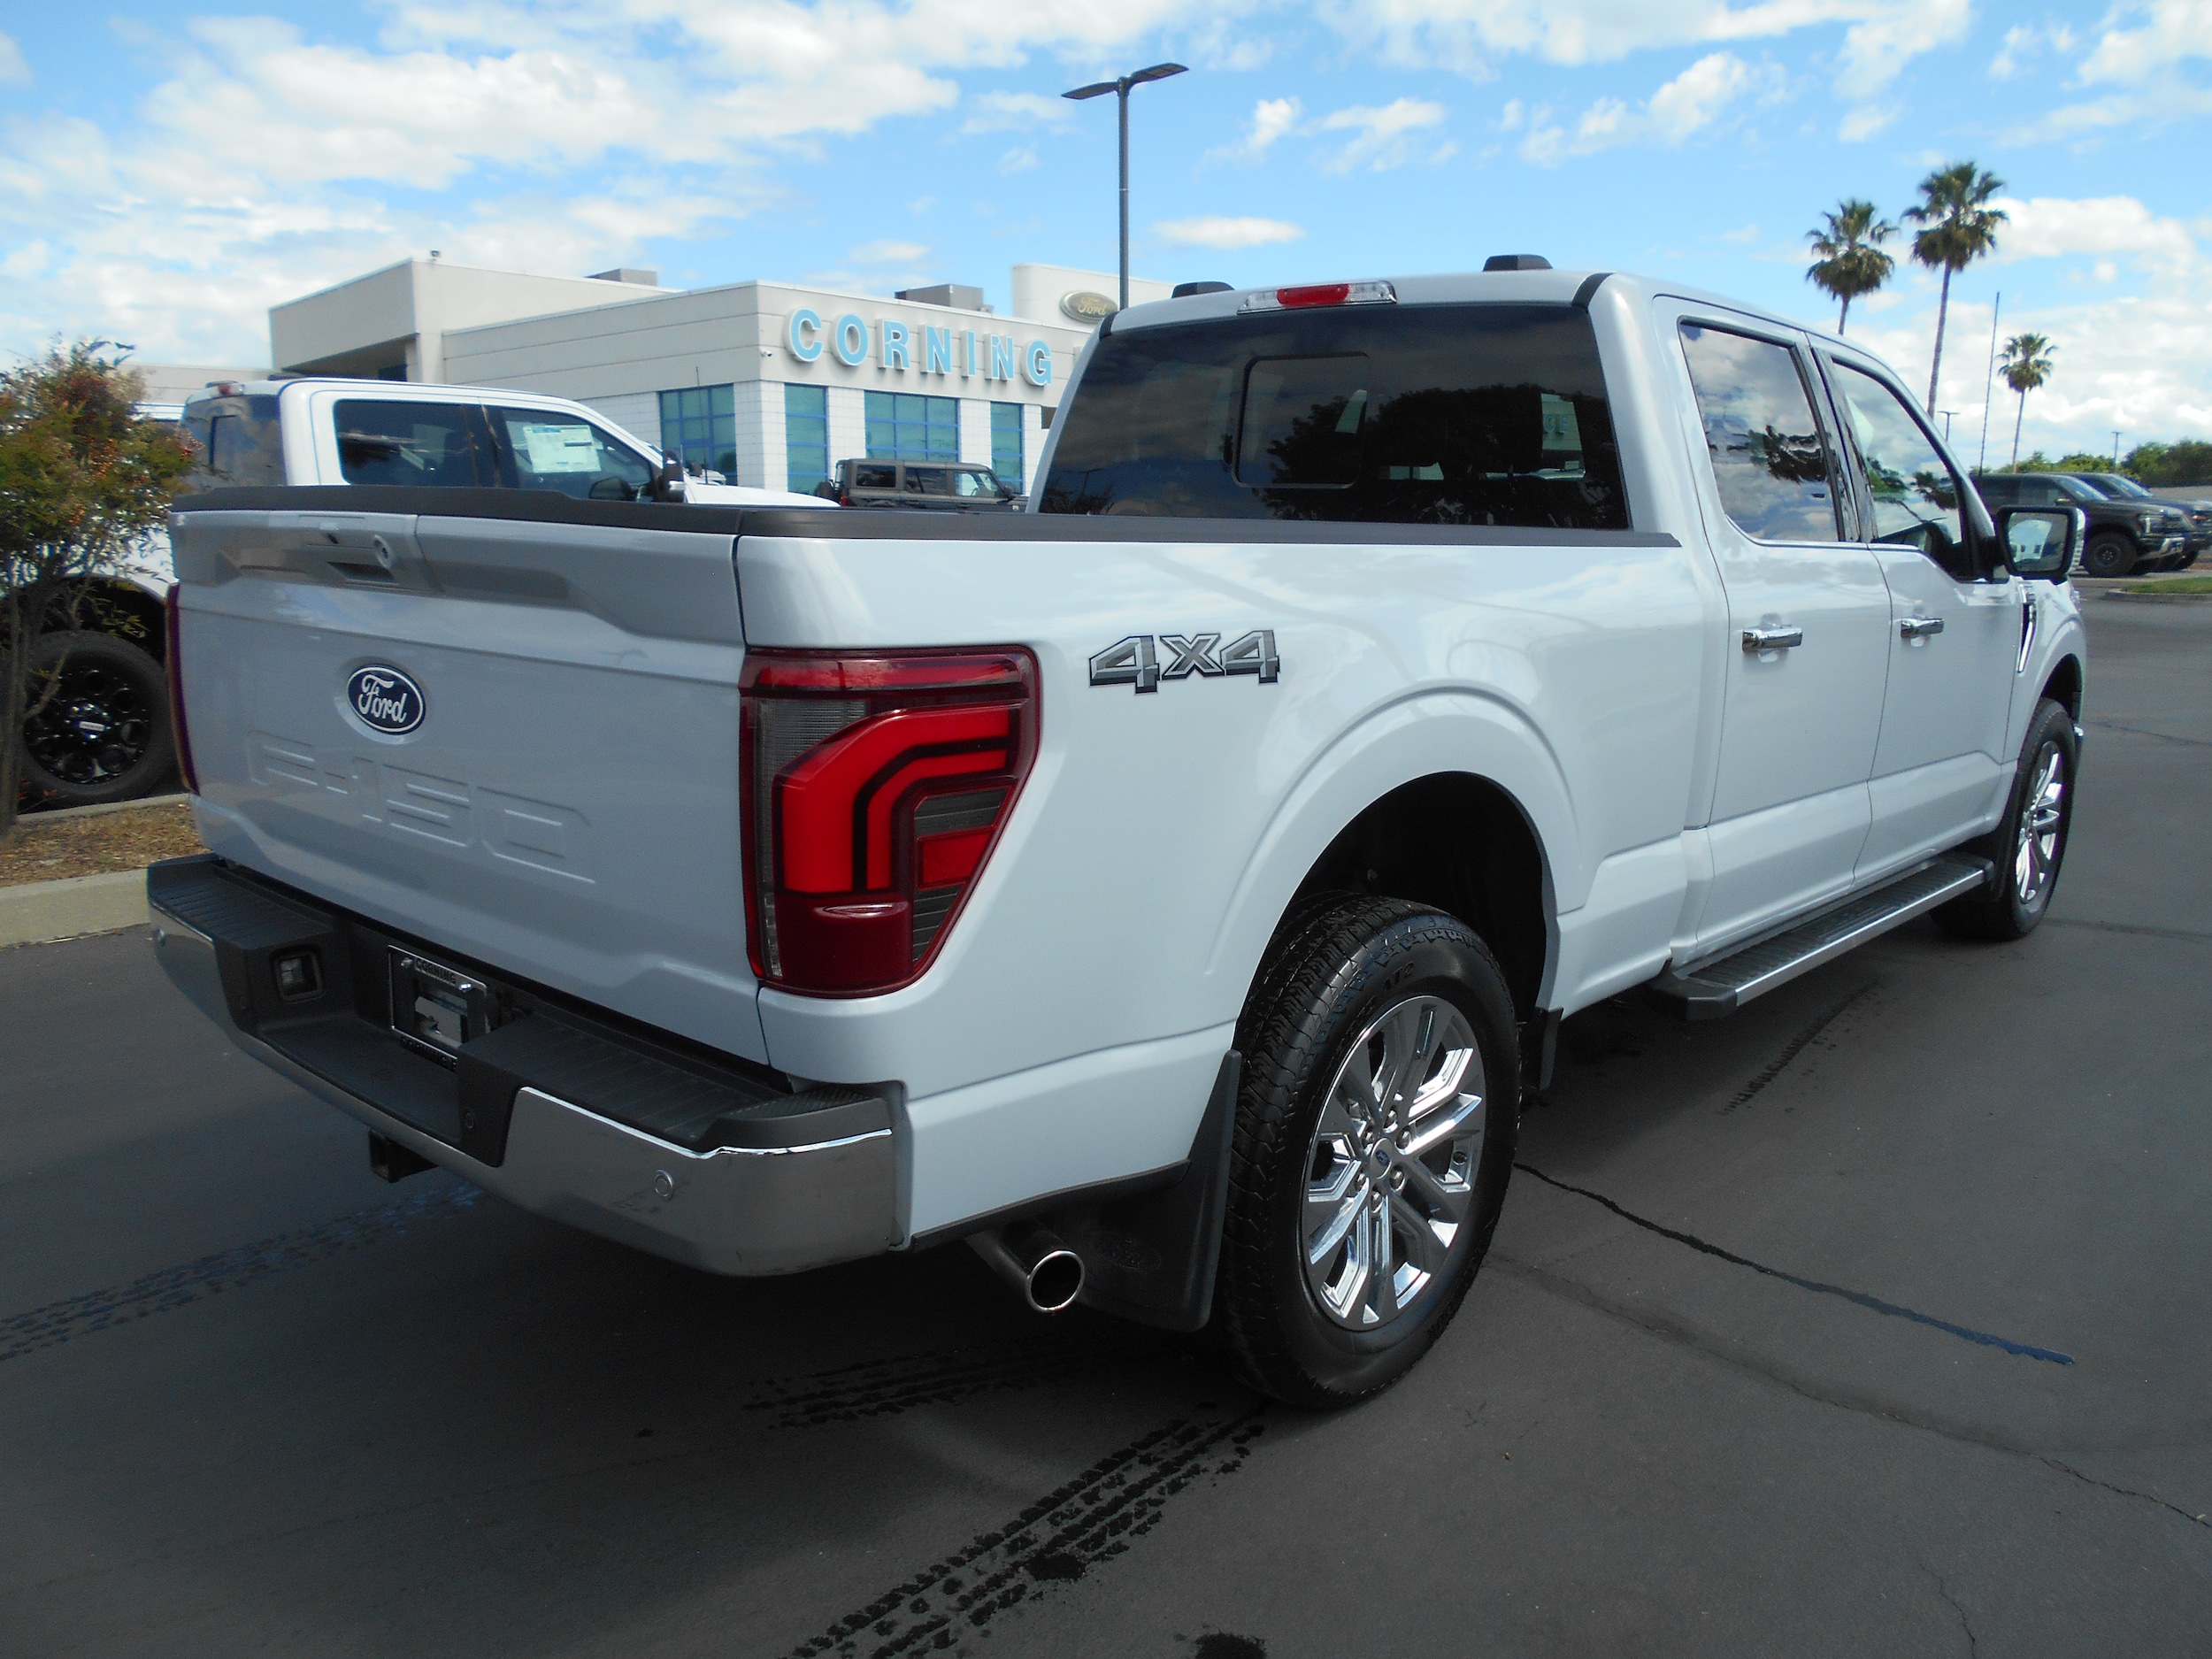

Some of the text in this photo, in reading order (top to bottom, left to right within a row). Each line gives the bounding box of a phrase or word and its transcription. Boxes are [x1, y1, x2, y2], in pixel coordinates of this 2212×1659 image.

[1078, 296, 1107, 316] Ford
[784, 307, 1053, 387] CORNING
[357, 674, 408, 723] Ford
[249, 729, 597, 885] F-150
[416, 957, 457, 984] CORNING
